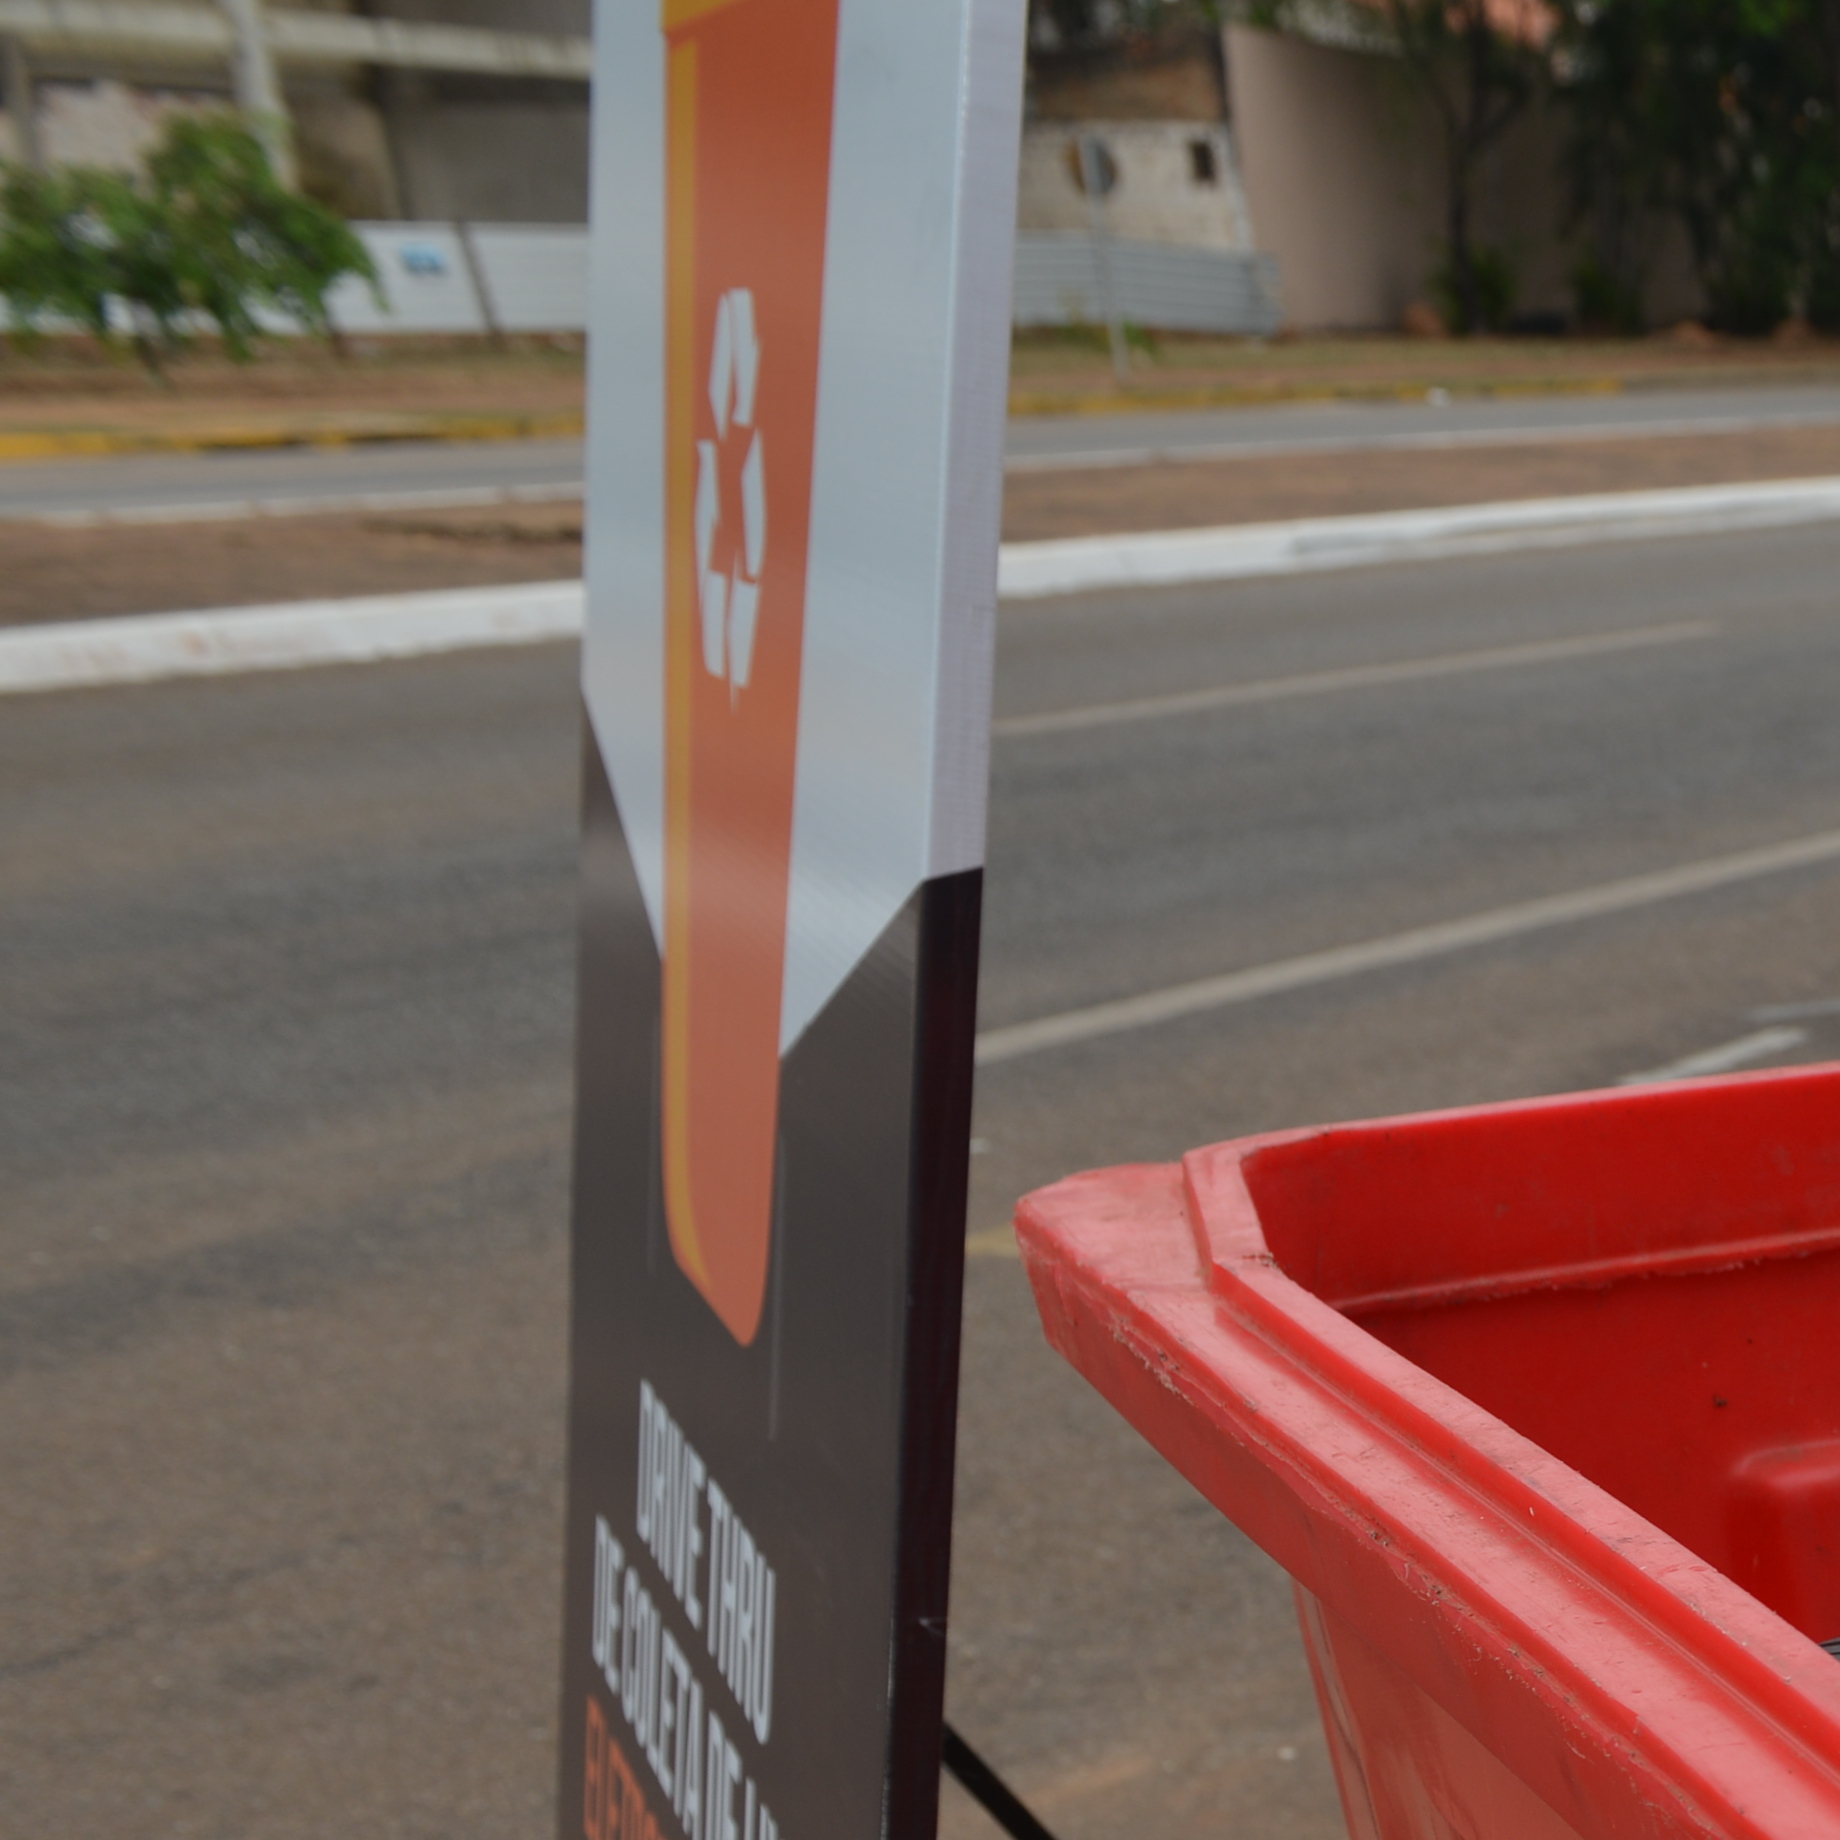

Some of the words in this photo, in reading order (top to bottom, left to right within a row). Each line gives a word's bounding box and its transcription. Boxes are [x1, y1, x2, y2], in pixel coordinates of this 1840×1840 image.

[591, 1516, 624, 1692] DE
[638, 1380, 703, 1623] DRIVE
[705, 1497, 776, 1742] THRU
